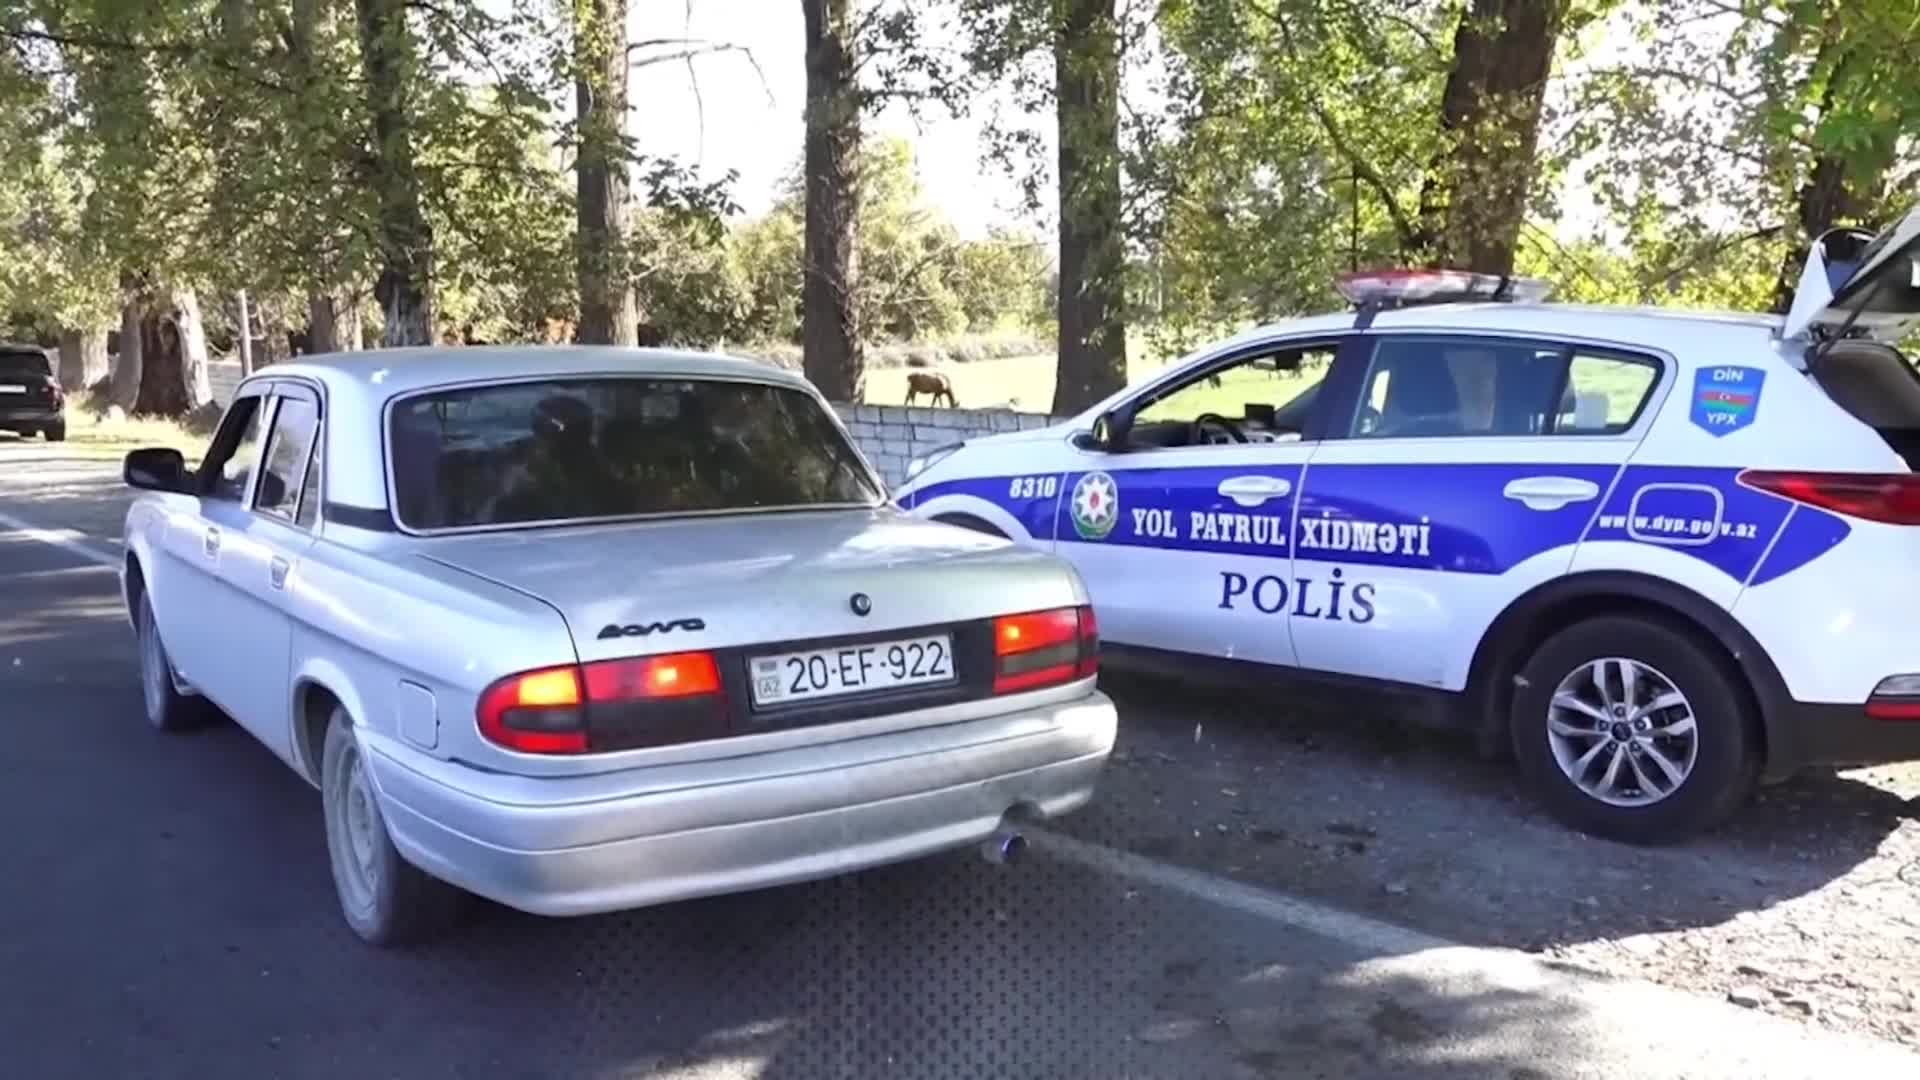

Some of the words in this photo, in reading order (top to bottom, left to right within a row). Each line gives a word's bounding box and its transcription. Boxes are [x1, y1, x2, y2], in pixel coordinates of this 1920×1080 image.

[1713, 368, 1743, 382] DİN
[1707, 413, 1737, 425] YPX
[1009, 477, 1056, 499] 8310
[1132, 509, 1177, 538] YOL
[1190, 513, 1286, 546] PATRUL
[1300, 511, 1431, 556] XİDMƏTİ
[1218, 568, 1376, 623] POLİS
